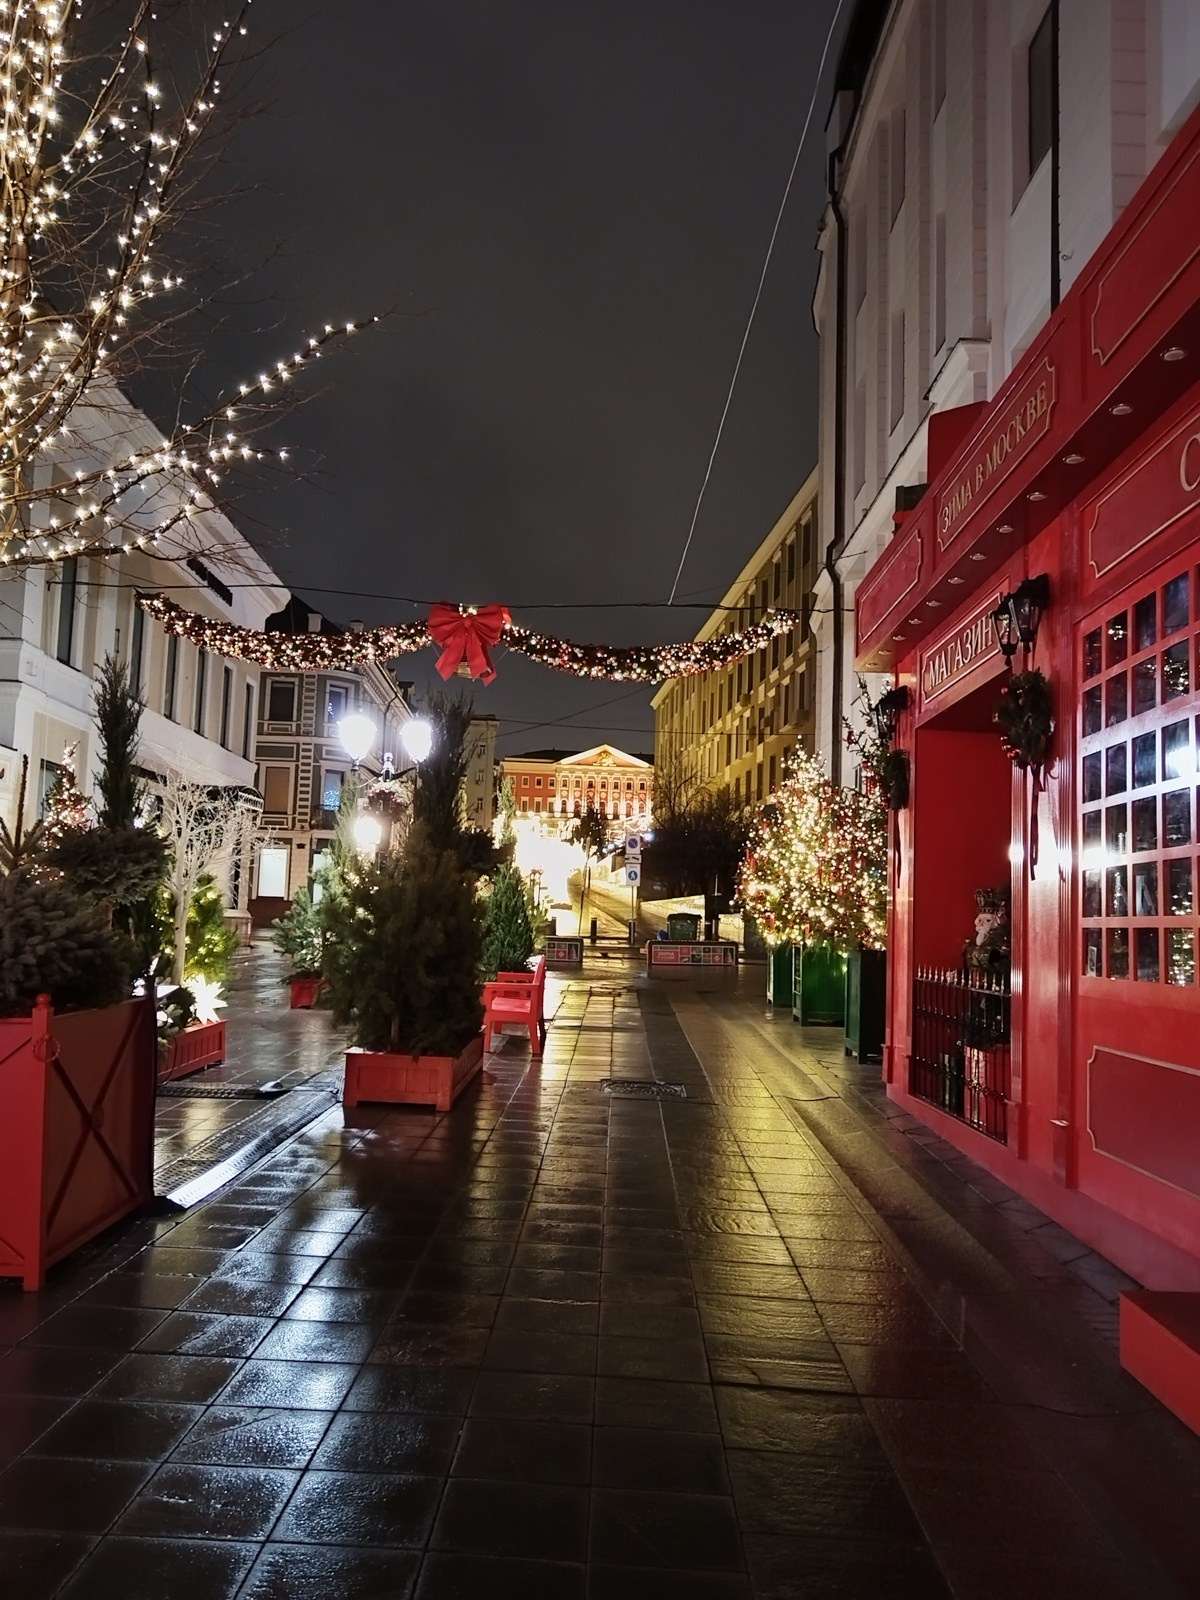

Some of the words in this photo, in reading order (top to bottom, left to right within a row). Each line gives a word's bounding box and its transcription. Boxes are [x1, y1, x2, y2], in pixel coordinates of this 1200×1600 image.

[942, 479, 973, 533] ЗИМА
[975, 463, 984, 493] В
[985, 381, 1047, 479] МОСКВЕ
[928, 610, 994, 690] МАГАЗИН
